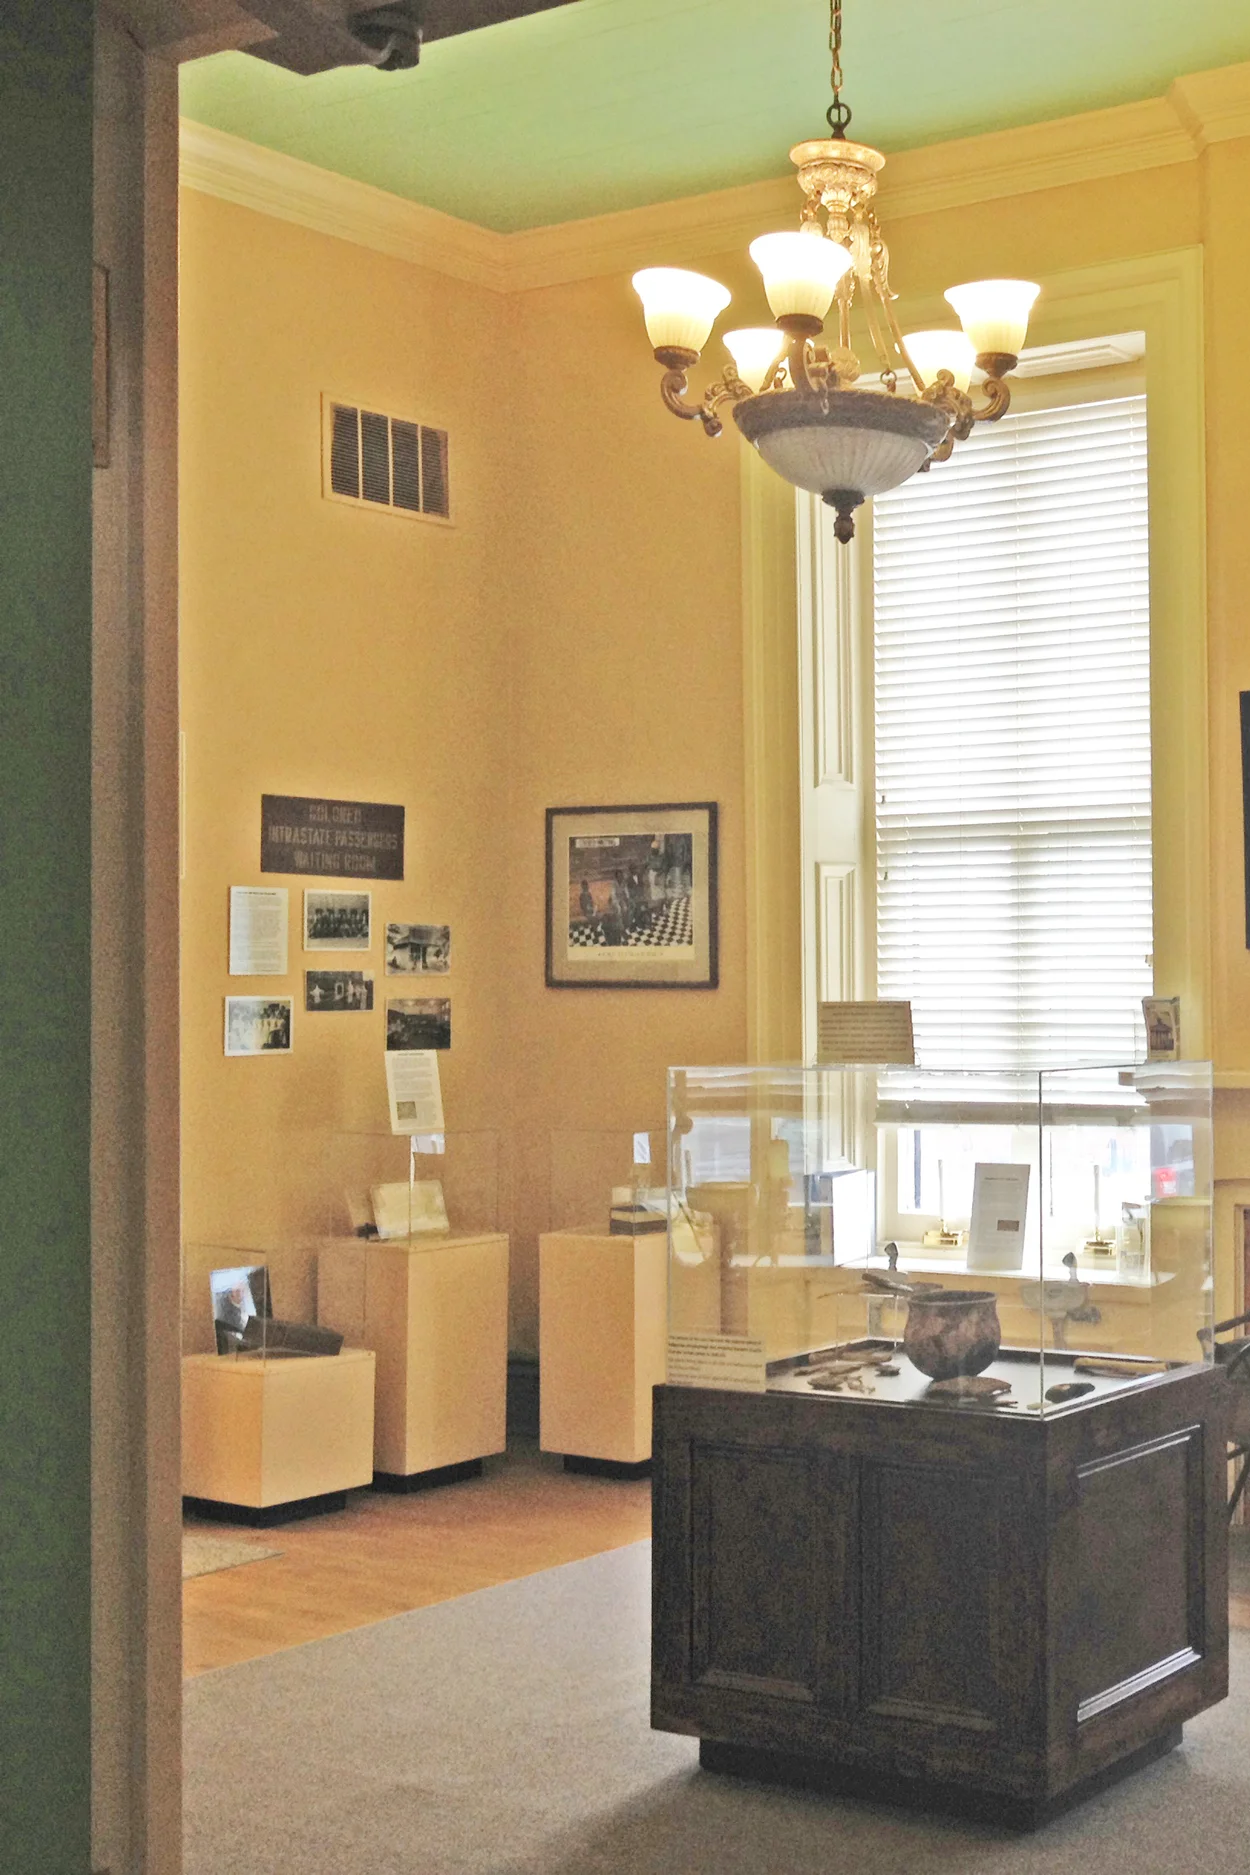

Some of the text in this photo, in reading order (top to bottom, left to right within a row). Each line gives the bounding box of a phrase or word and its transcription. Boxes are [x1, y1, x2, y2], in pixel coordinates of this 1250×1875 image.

[268, 825, 331, 846] INTRASTATE
[294, 850, 377, 873] WAITING ROOM
